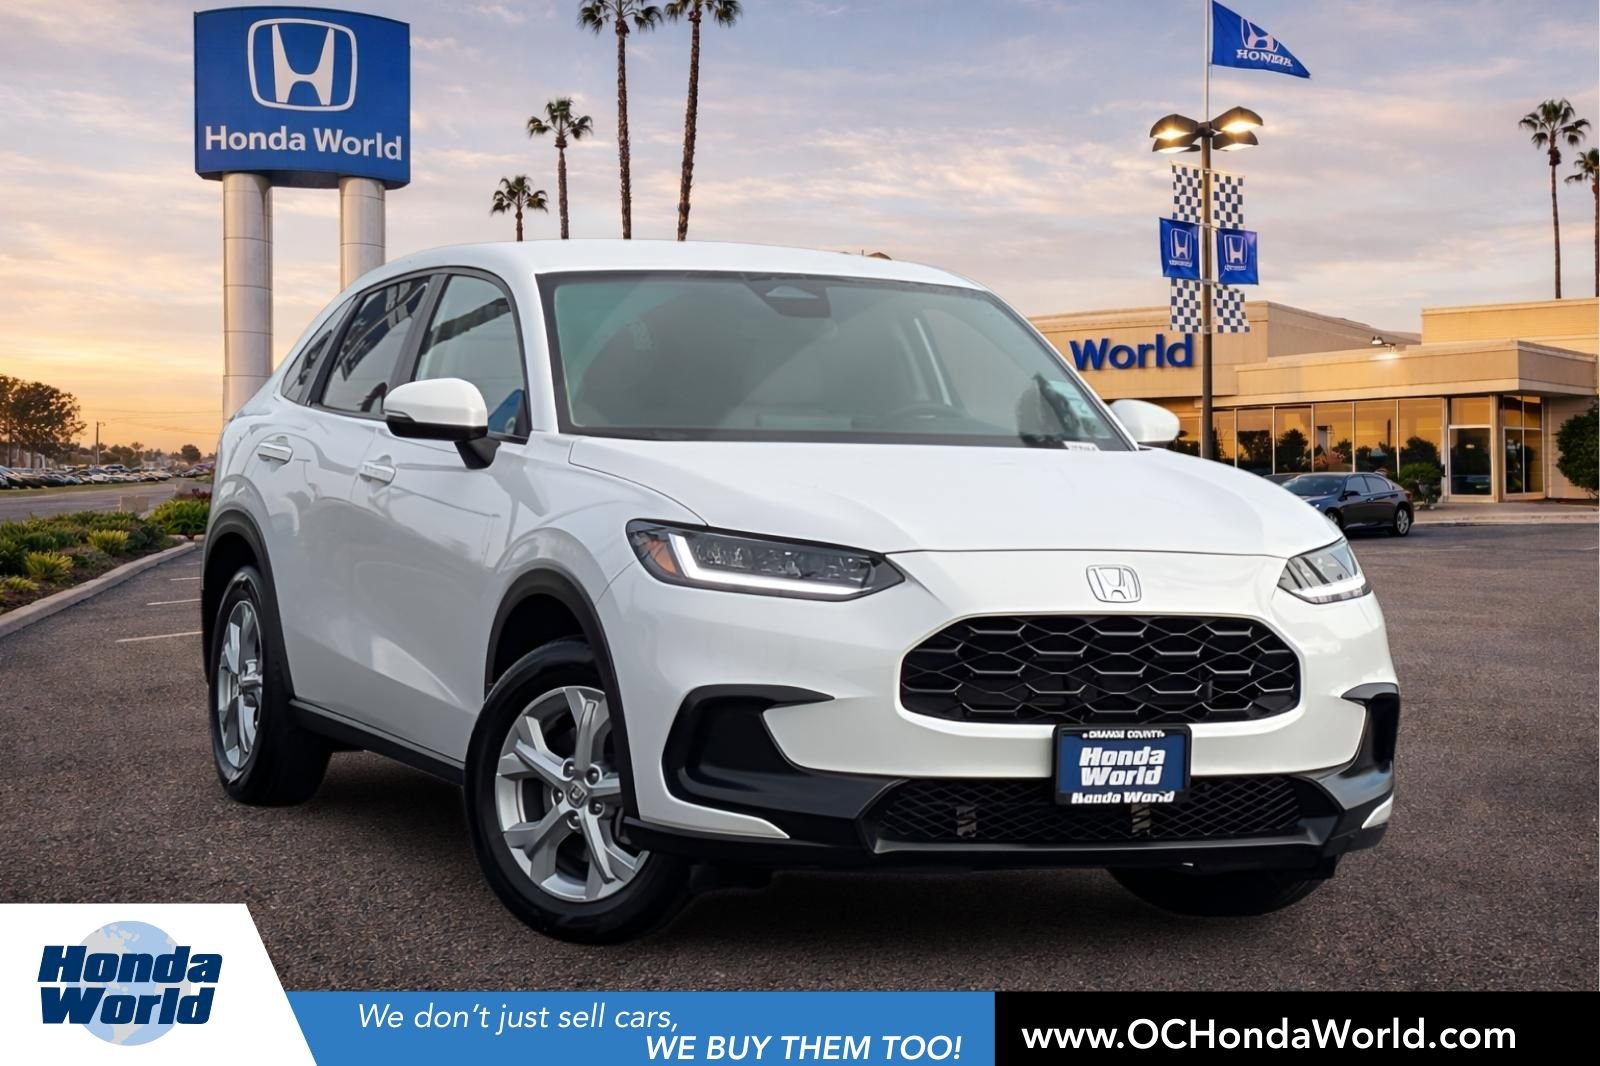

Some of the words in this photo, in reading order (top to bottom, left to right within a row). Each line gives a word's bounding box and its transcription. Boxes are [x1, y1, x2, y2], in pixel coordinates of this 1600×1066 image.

[205, 125, 306, 151] Honda
[313, 127, 402, 160] World
[1069, 333, 1193, 371] World
[1079, 746, 1166, 766] Honda
[1081, 766, 1163, 786] World
